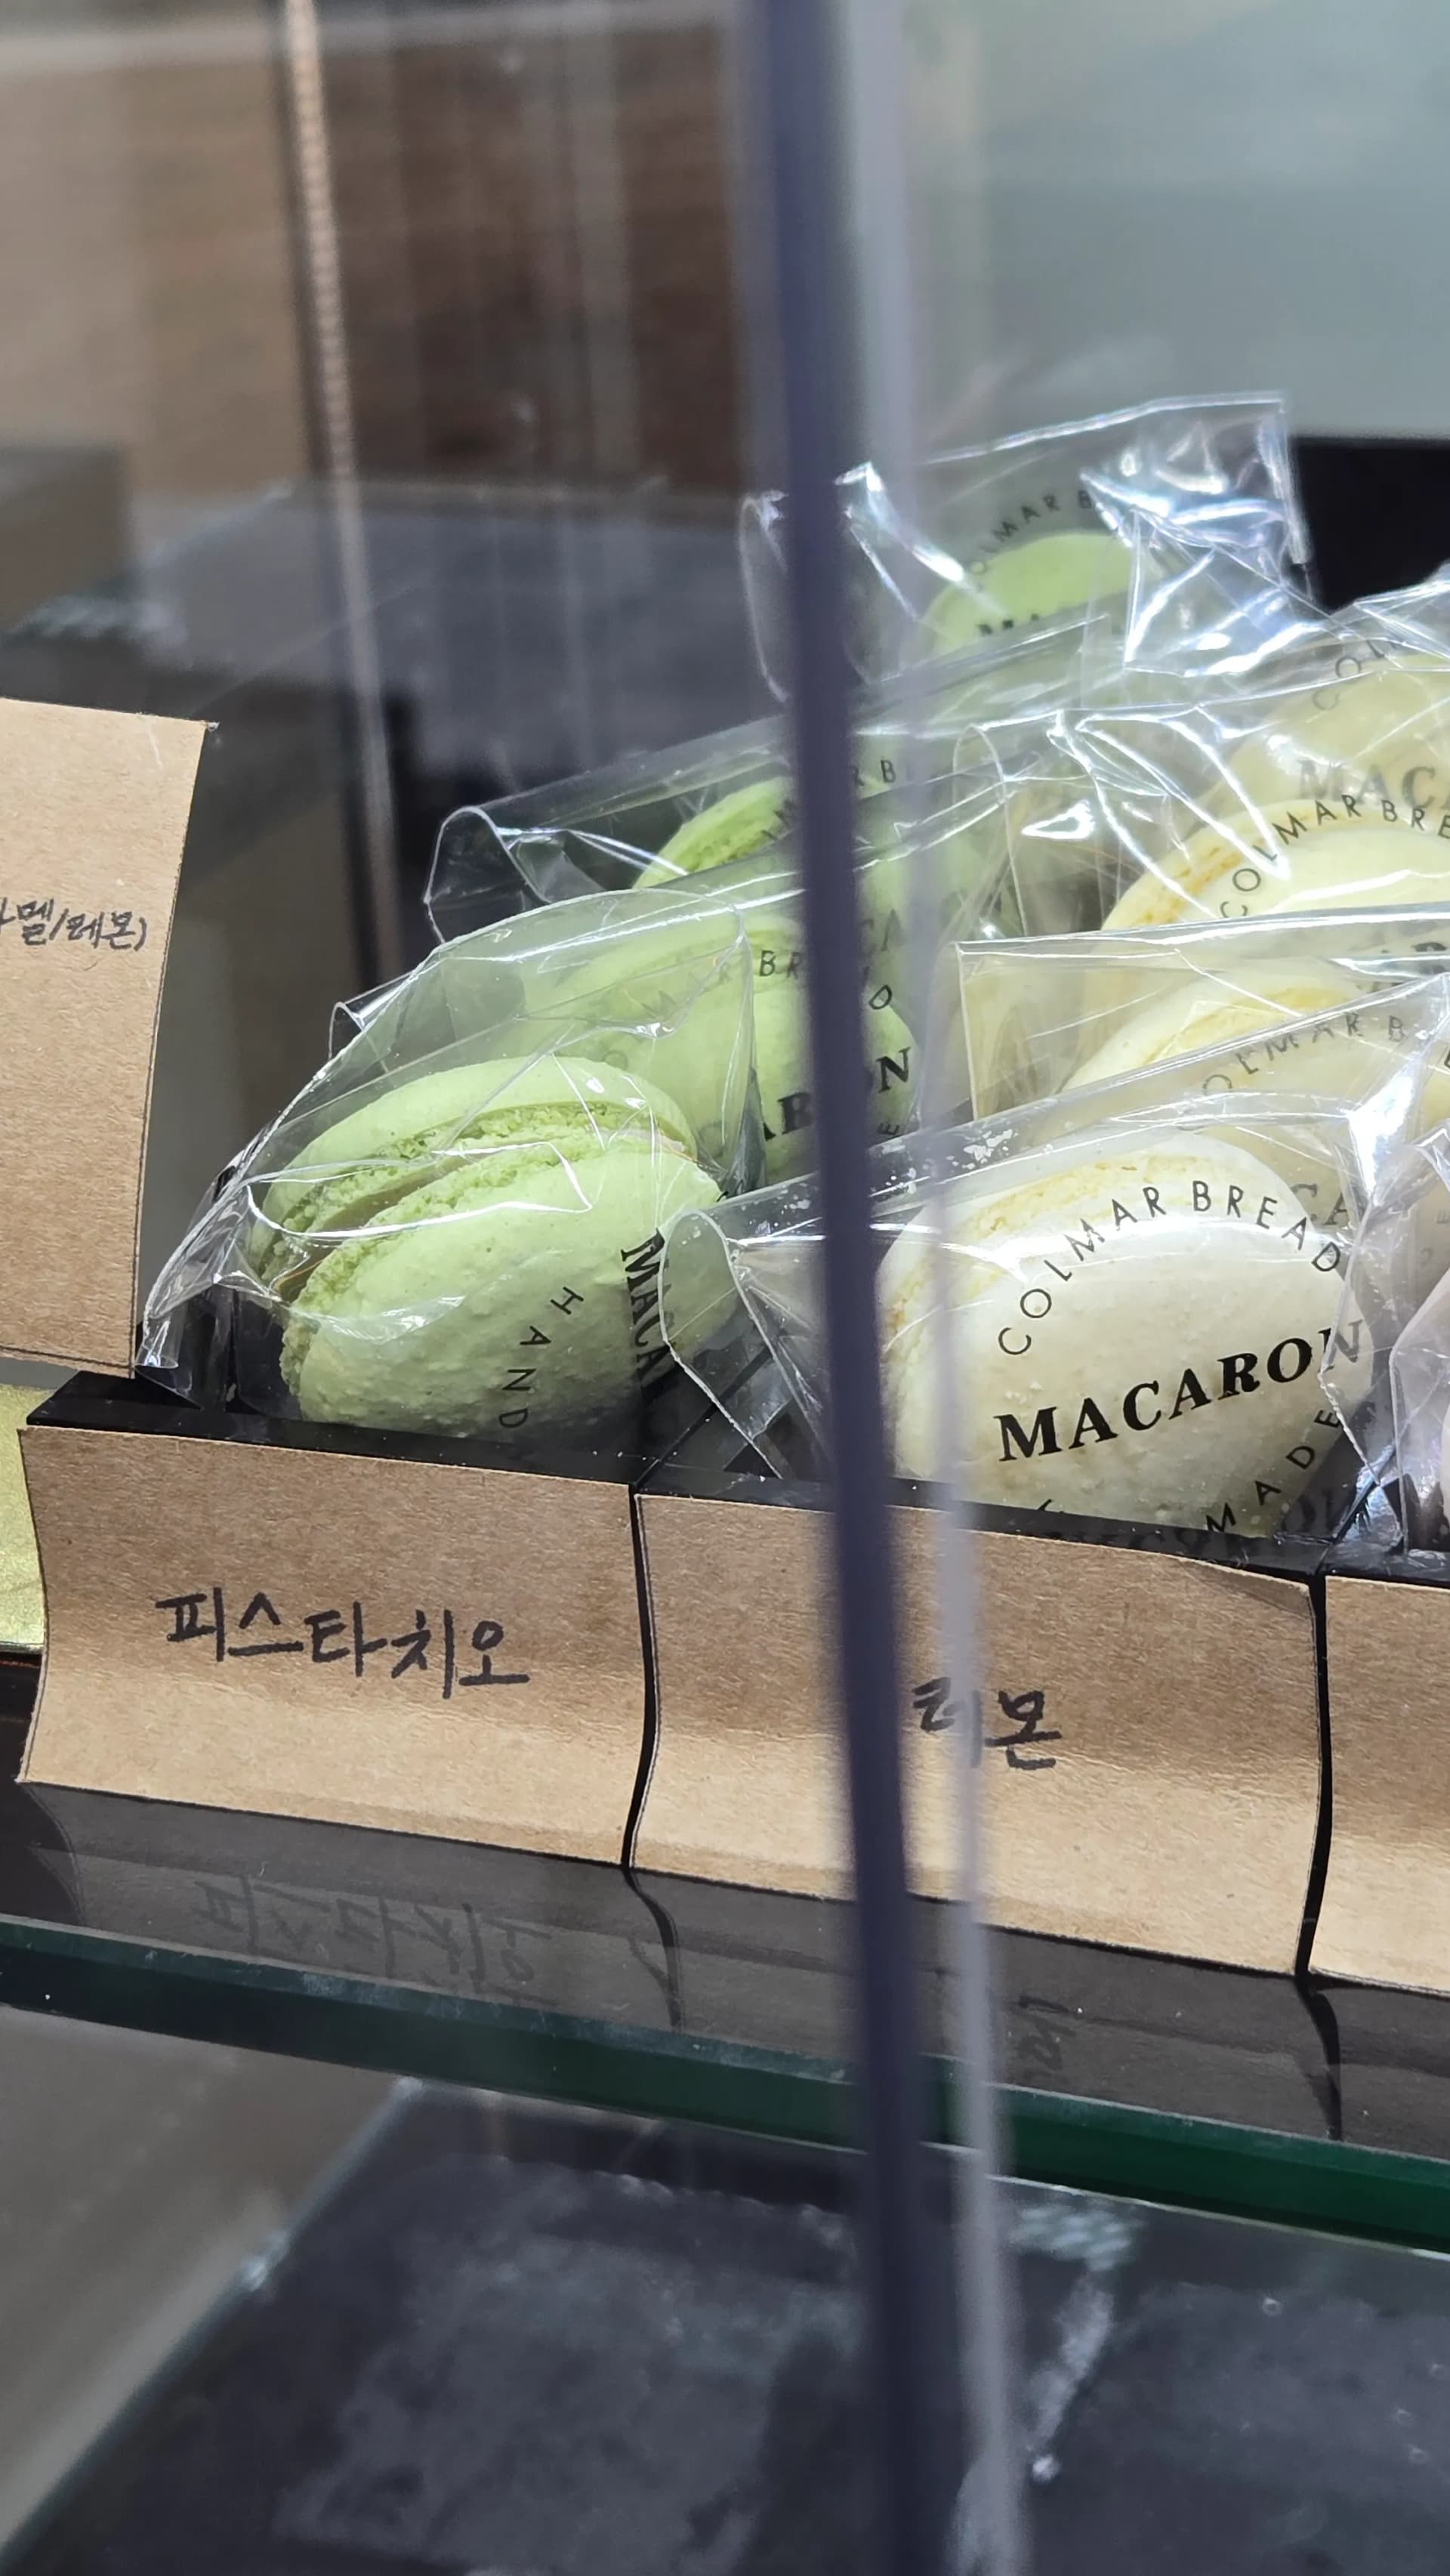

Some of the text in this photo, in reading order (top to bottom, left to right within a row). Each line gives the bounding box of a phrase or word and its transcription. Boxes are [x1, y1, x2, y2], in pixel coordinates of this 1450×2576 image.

[968, 493, 1060, 576] OLMAR
[1219, 793, 1362, 919] COLMAR
[1195, 1011, 1364, 1104] OLMAR
[998, 1180, 1342, 1356] COLMAR BREAD
[498, 1286, 585, 1429] HAND
[993, 1320, 1363, 1463] MACARON
[1206, 1408, 1344, 1533] MADE
[156, 1587, 529, 1699] 피스타치오
[912, 1676, 1062, 1770] 레몬
